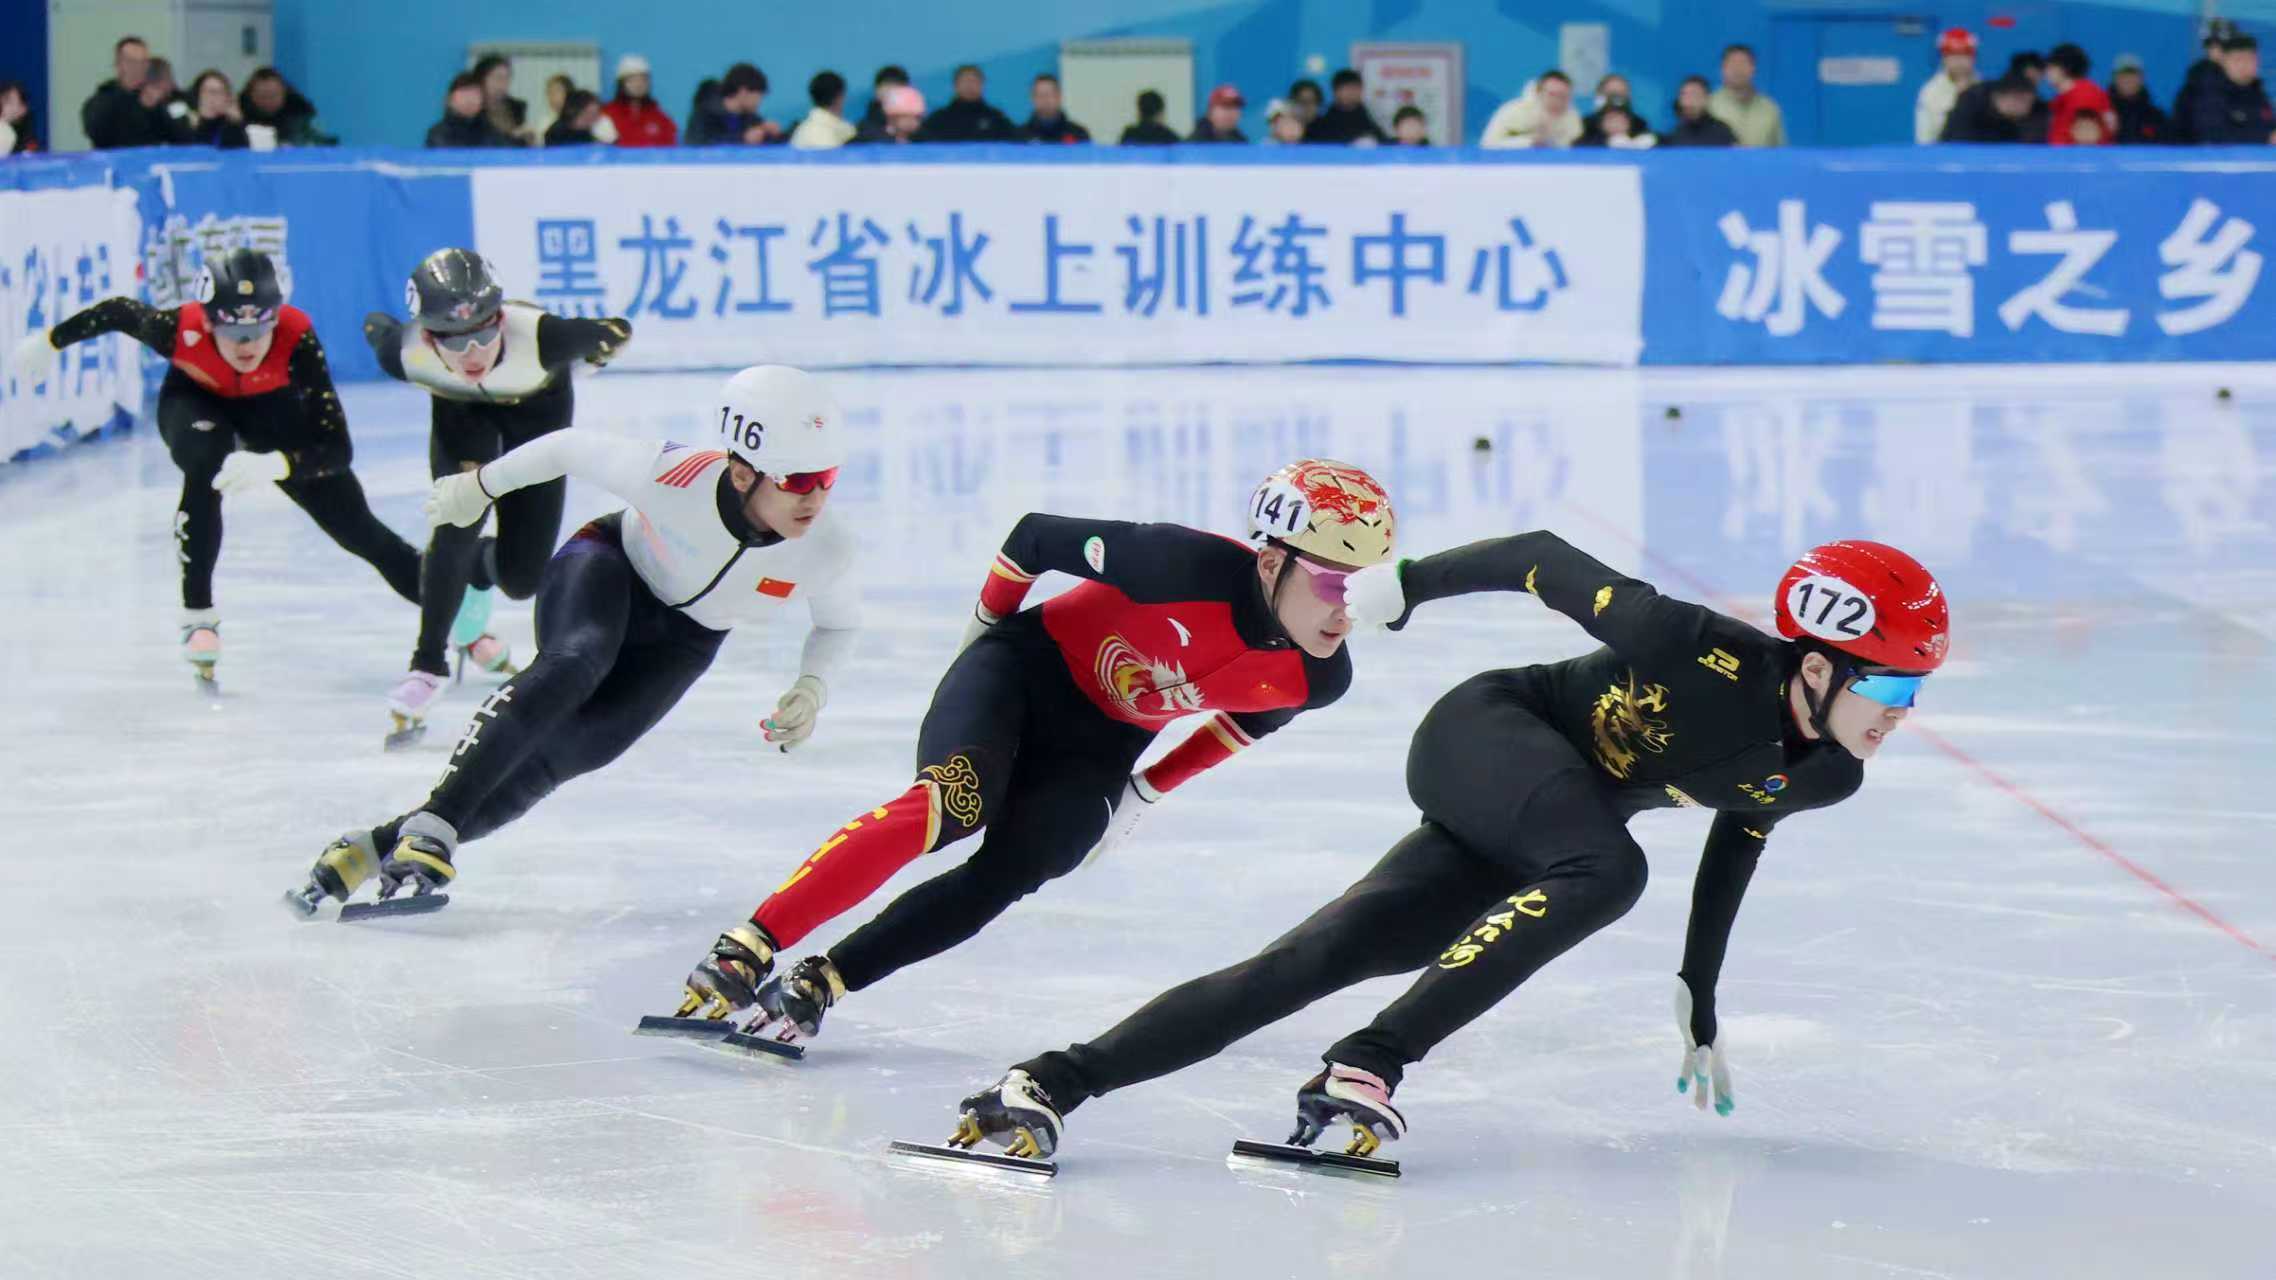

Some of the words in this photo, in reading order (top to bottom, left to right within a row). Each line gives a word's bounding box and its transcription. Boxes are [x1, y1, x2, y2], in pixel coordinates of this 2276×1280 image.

[533, 213, 1569, 319] 黑龙江省冰上训练中心
[1717, 200, 2262, 336] 冰雪之乡
[719, 406, 765, 452] 116
[1255, 487, 1304, 532] 141
[1797, 582, 1869, 637] 172
